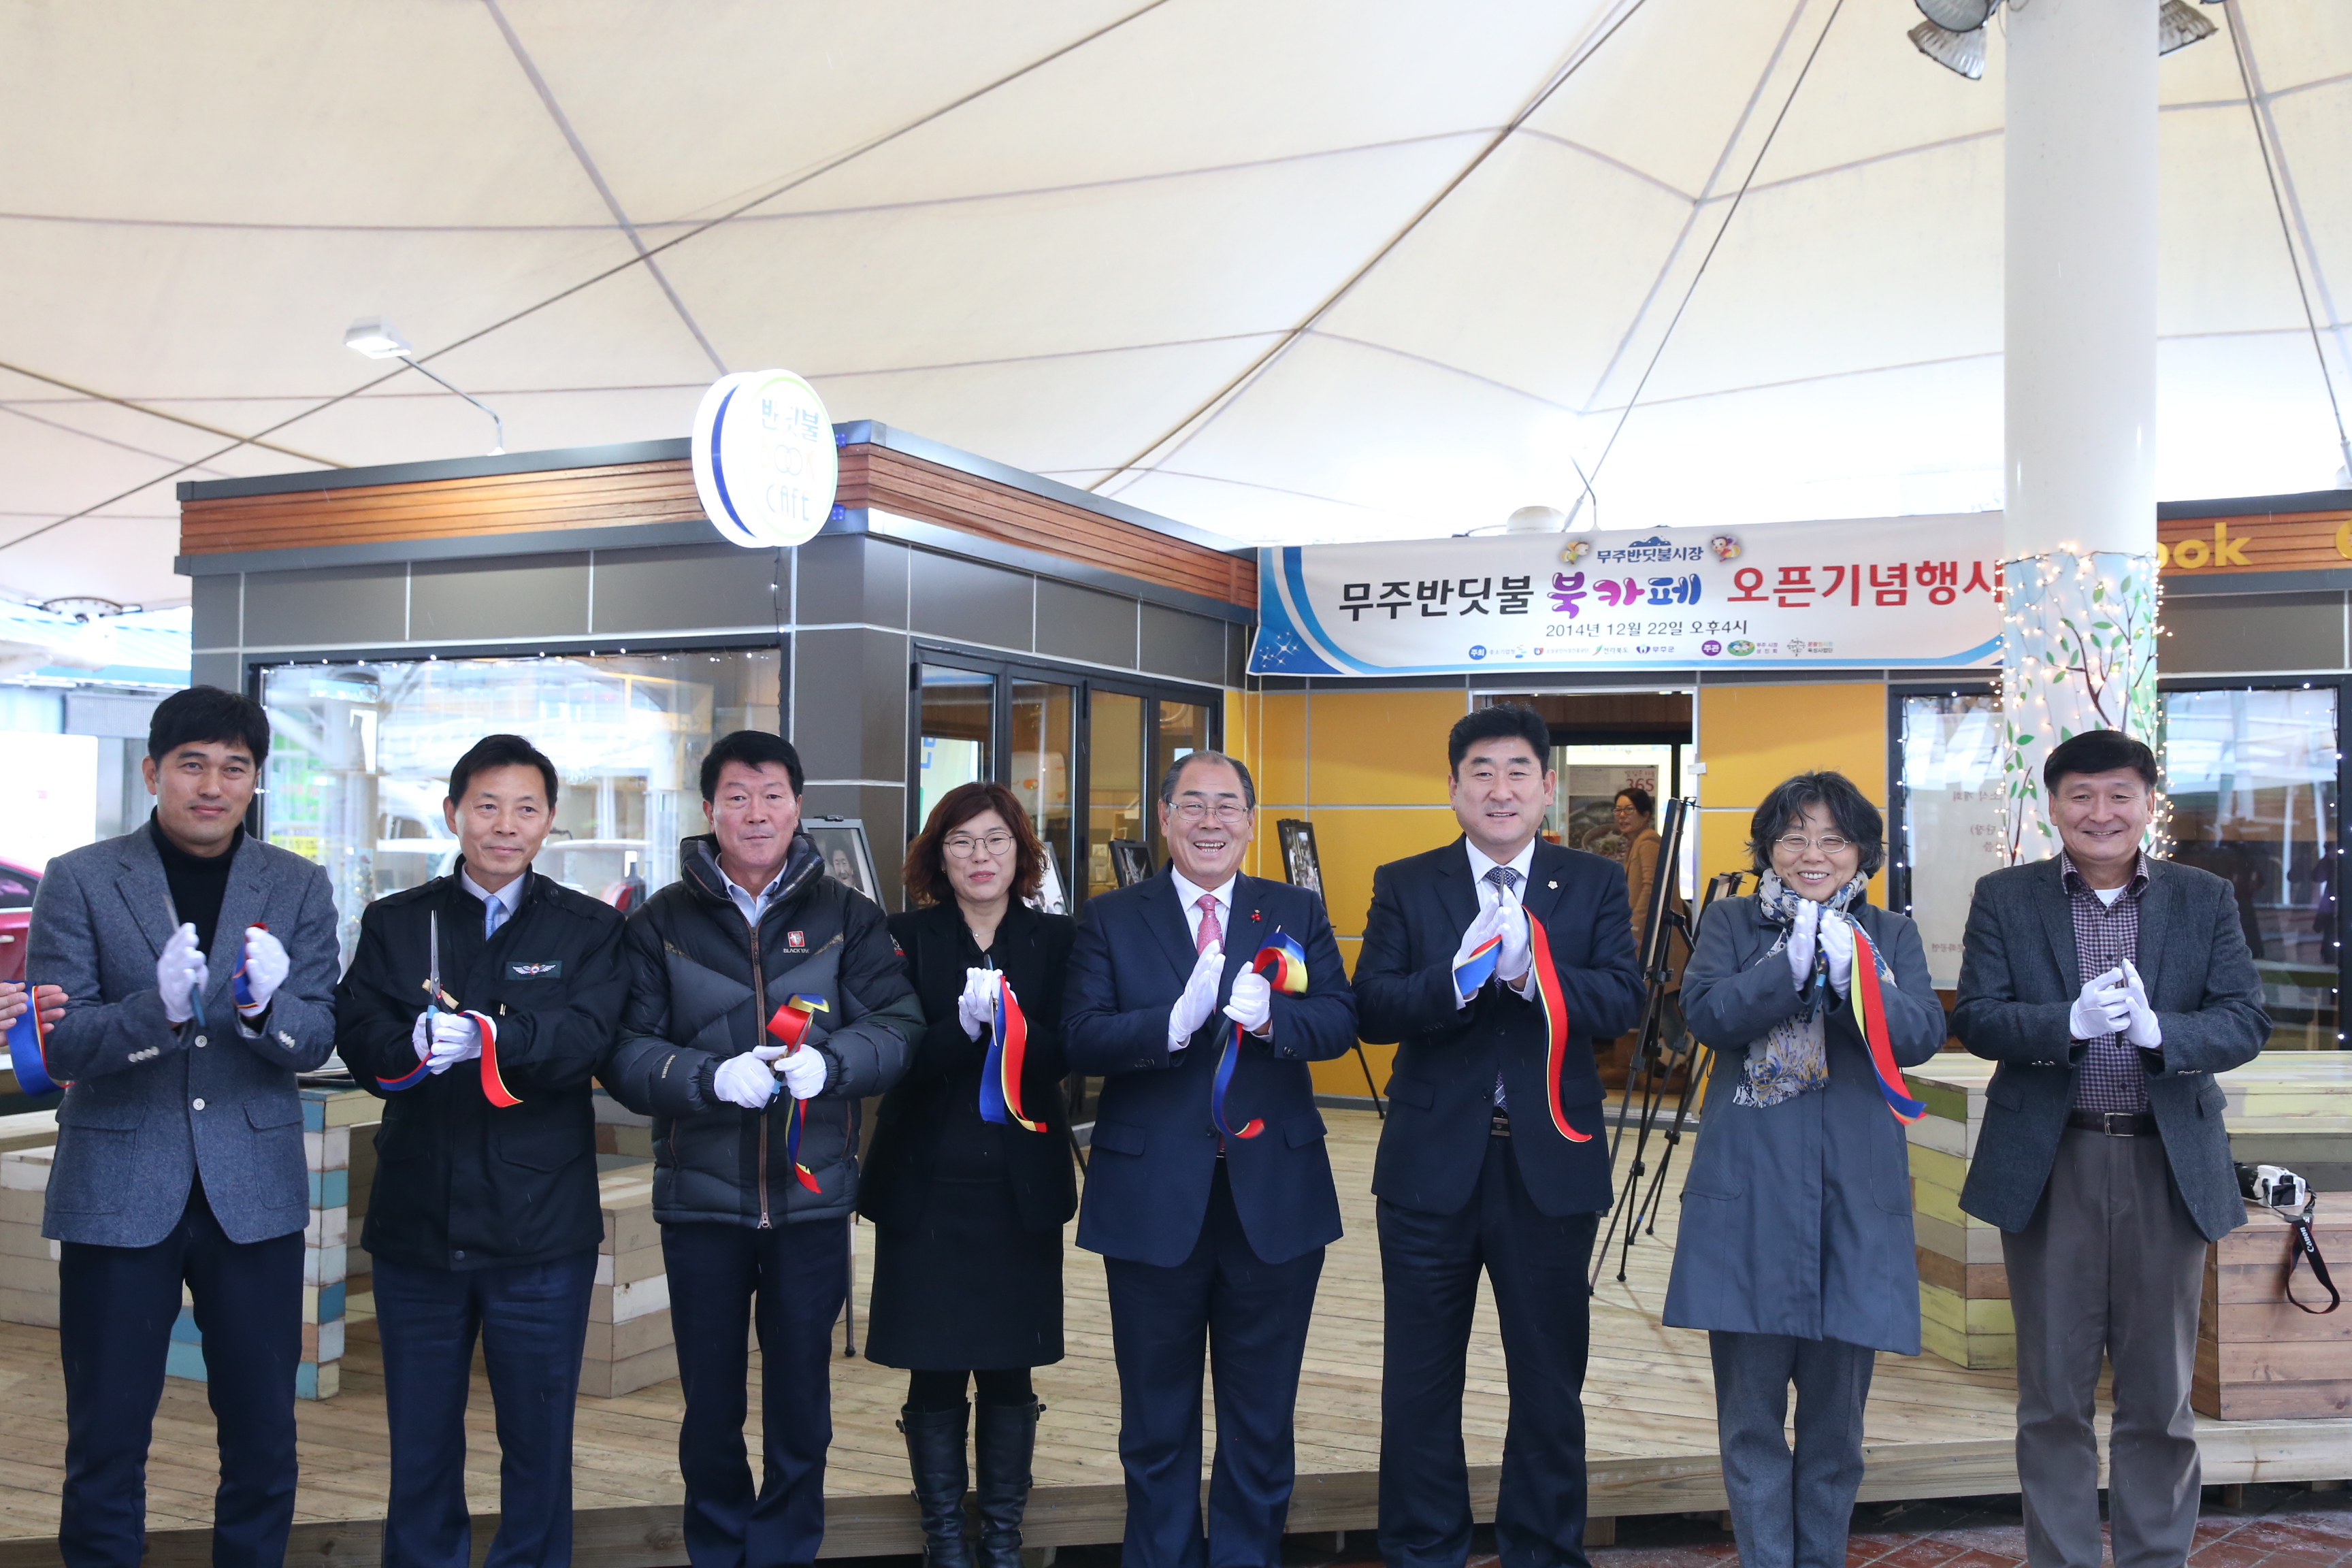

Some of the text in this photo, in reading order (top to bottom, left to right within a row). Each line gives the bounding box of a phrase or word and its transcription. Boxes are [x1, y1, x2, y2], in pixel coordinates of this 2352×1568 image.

[1597, 546, 1704, 564] 무주반딧불시장
[1339, 576, 1535, 621] 무주반딧불
[1547, 571, 1701, 619] 북카페
[1546, 620, 1748, 637] 2014년 12월 22일 오후4시
[2300, 1226, 2315, 1253] Canon
